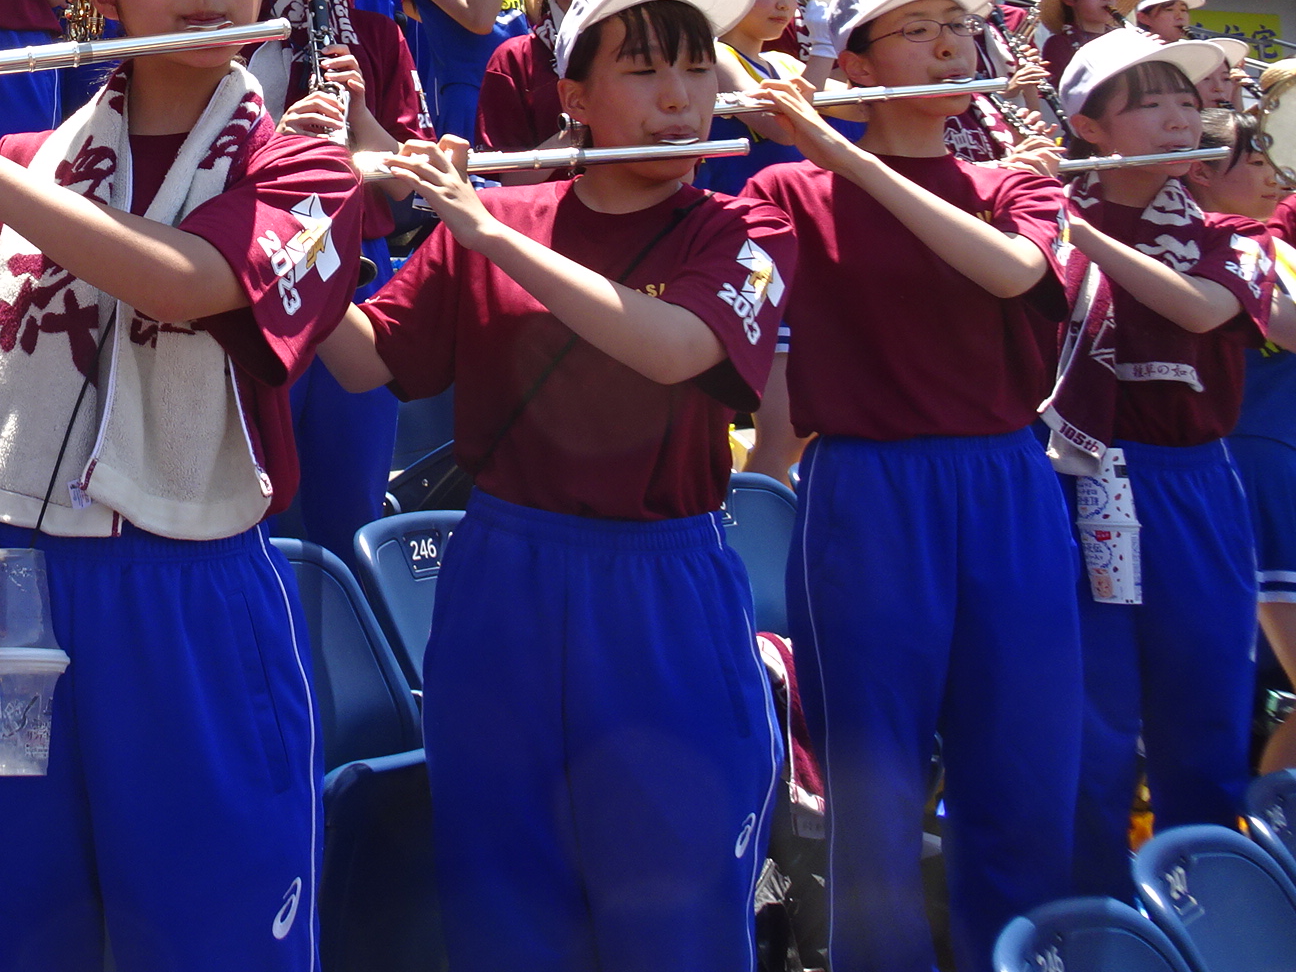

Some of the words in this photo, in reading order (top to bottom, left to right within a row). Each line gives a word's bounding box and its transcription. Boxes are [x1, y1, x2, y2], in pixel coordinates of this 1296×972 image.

[417, 112, 433, 128] 20
[256, 229, 302, 316] 2023
[717, 282, 761, 345] 2023
[1059, 422, 1099, 455] 105th
[409, 537, 437, 560] 246
